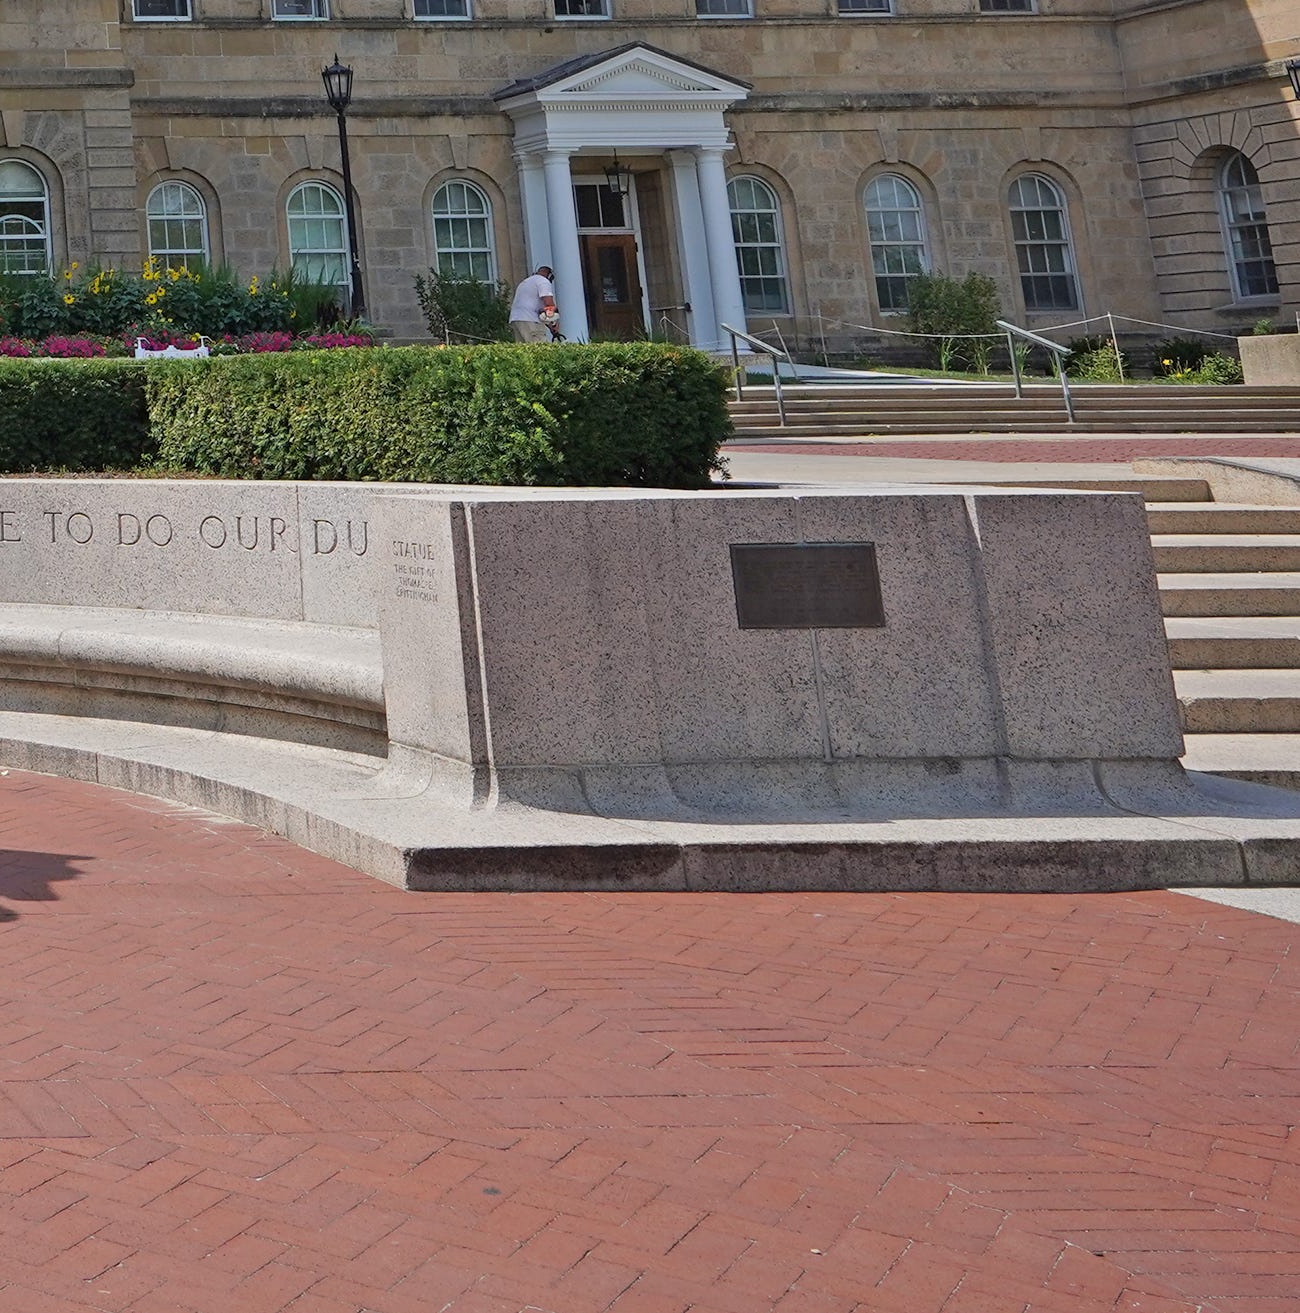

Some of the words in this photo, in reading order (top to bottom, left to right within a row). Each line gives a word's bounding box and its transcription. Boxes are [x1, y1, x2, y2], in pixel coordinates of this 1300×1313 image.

[43, 511, 94, 546] TO
[116, 513, 174, 547] DO
[200, 515, 298, 554] OUR
[393, 540, 435, 561] STATUE
[393, 564, 408, 575] THE
